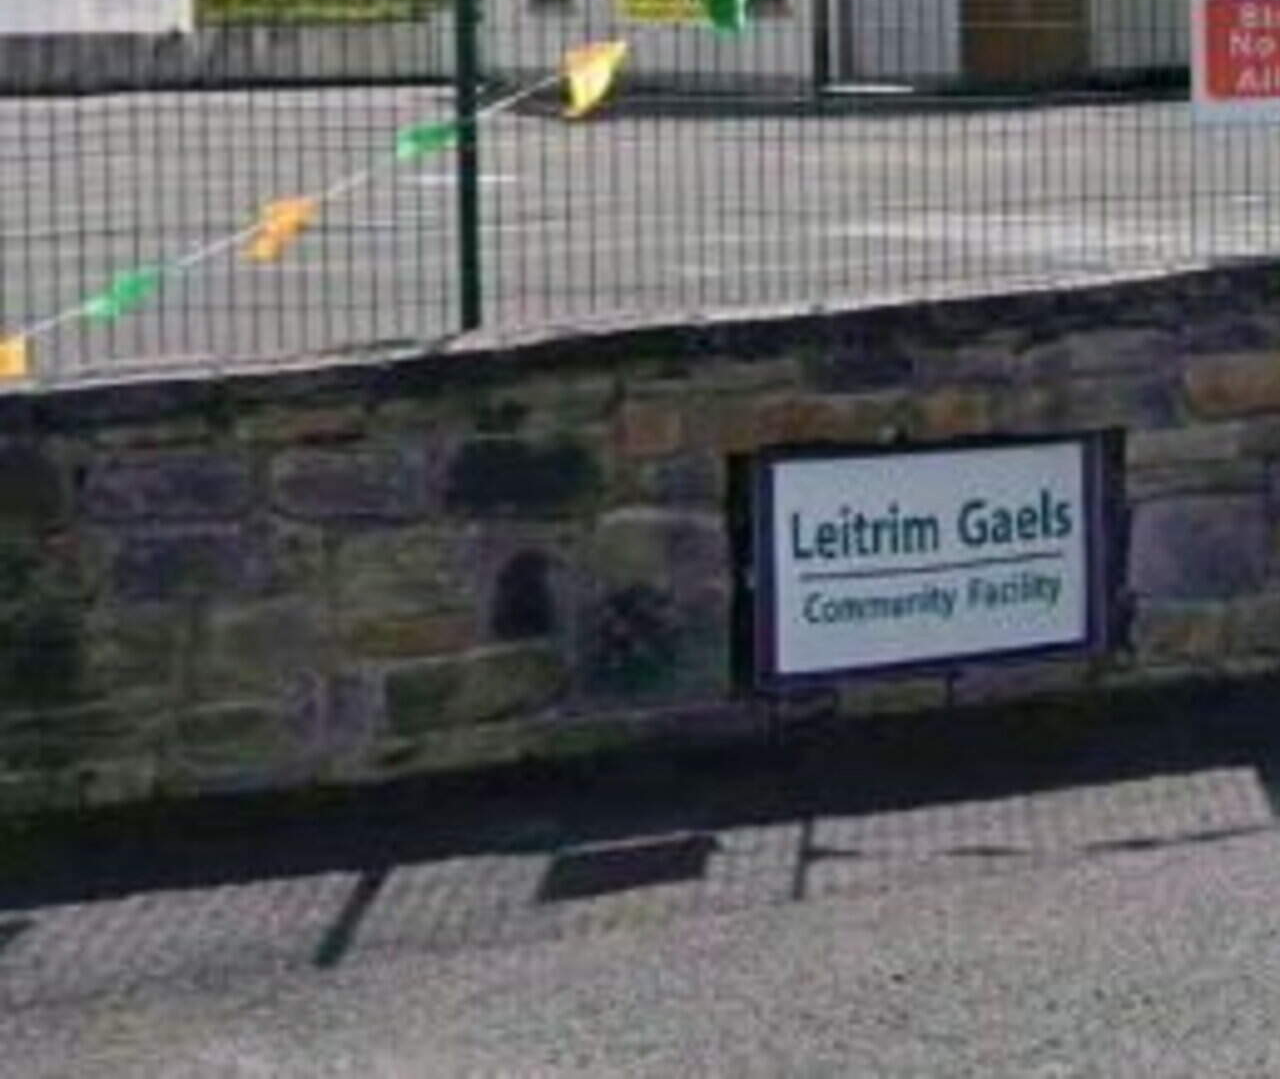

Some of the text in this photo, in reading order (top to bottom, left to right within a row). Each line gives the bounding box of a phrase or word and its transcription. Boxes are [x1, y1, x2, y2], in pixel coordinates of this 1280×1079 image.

[1229, 31, 1276, 57] No
[792, 488, 1073, 560] Leitrim Gaels
[803, 571, 1062, 625] Community Facility
